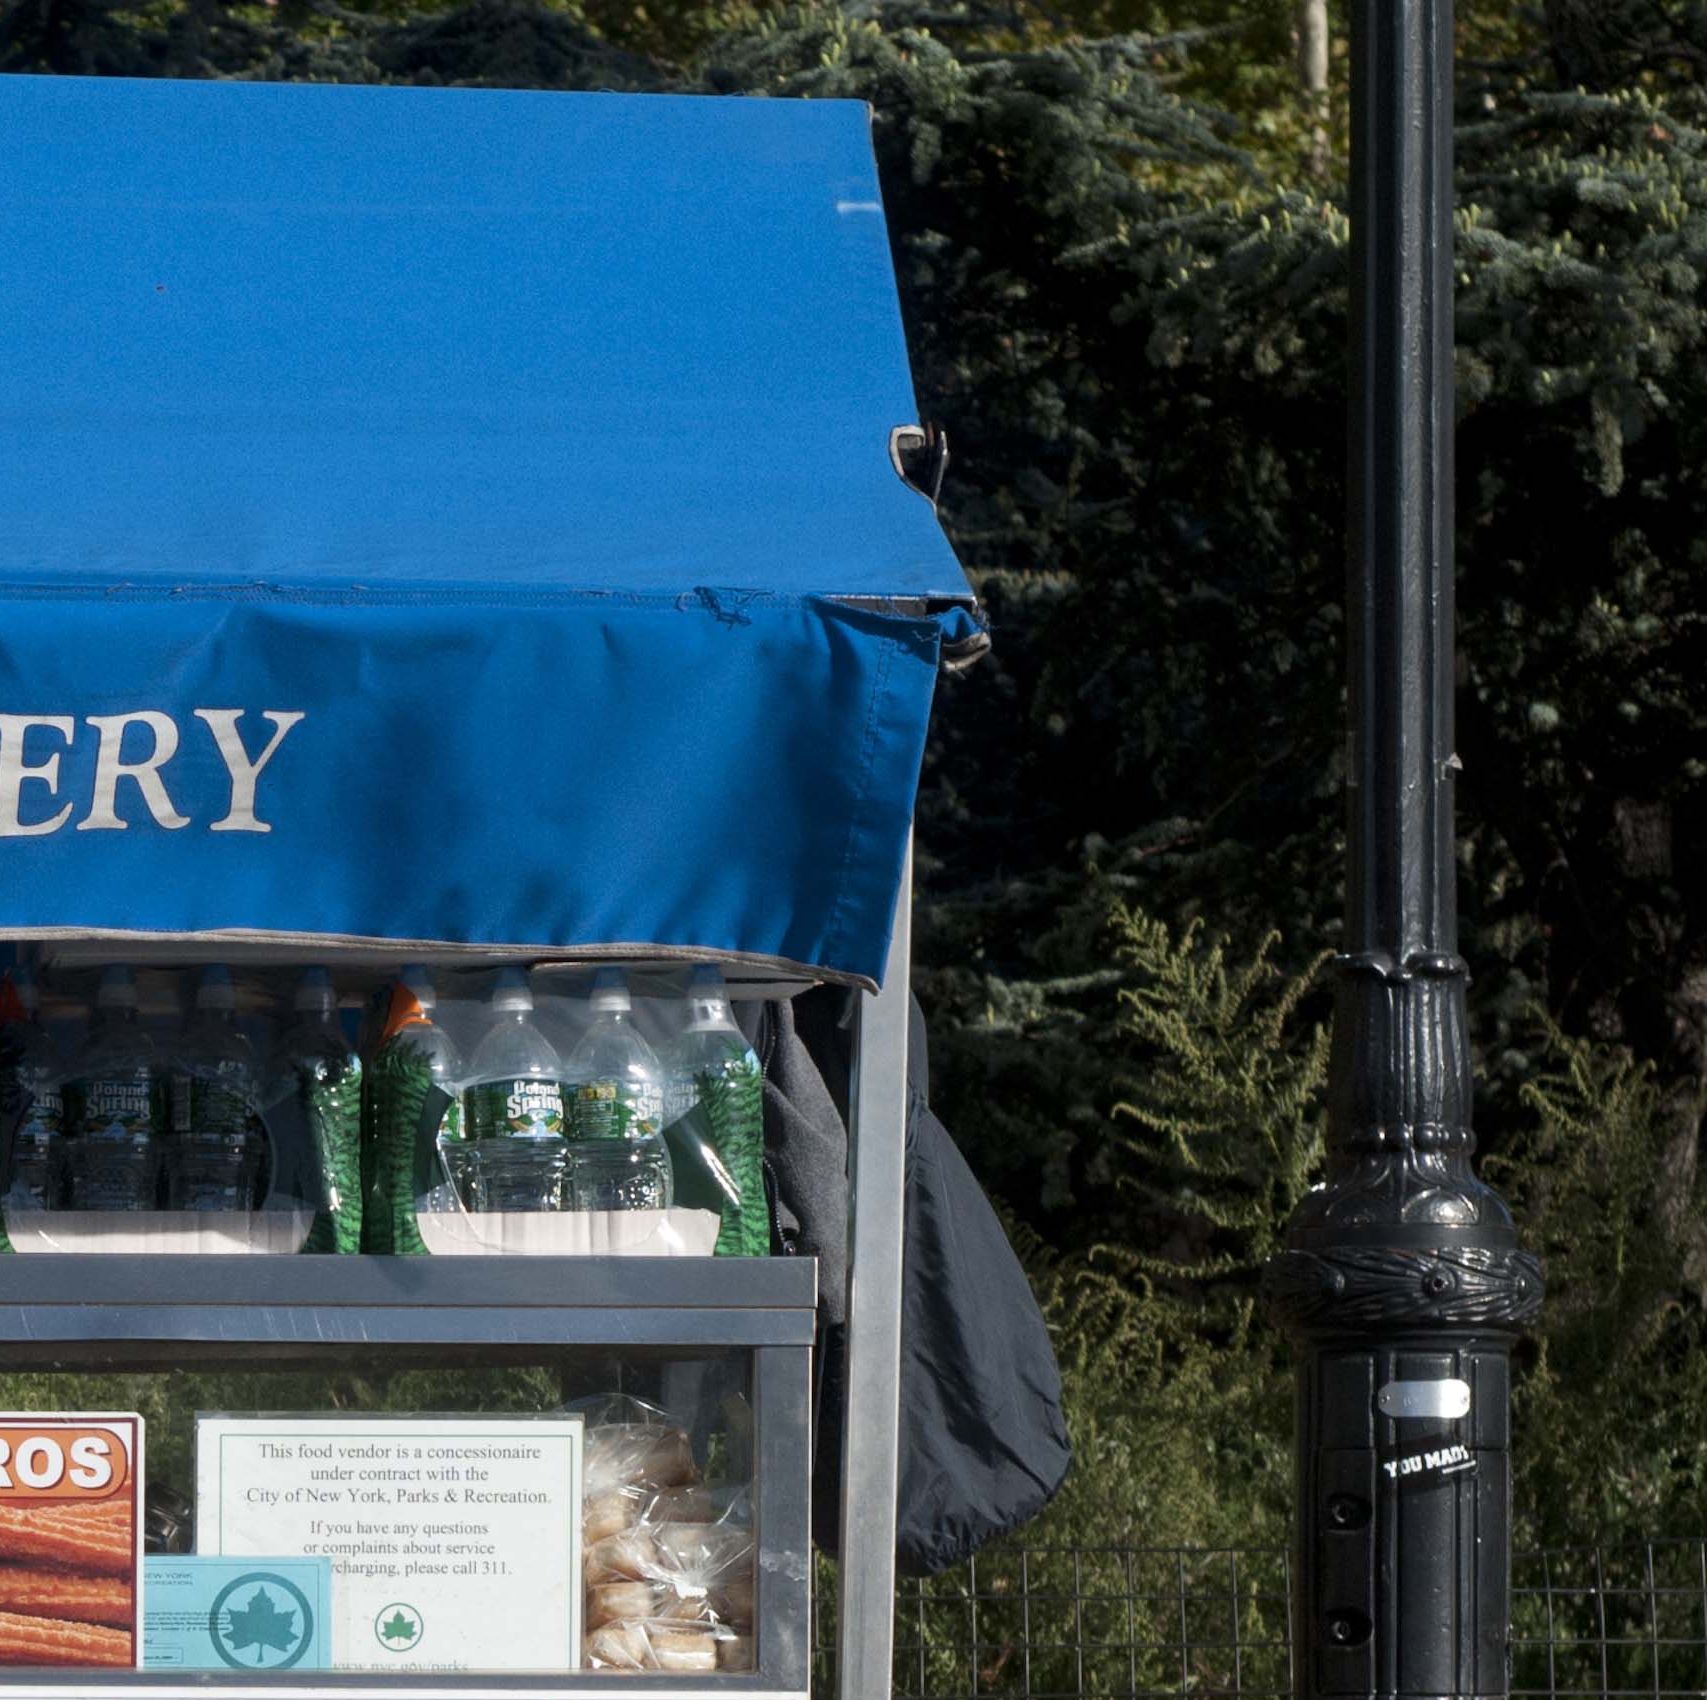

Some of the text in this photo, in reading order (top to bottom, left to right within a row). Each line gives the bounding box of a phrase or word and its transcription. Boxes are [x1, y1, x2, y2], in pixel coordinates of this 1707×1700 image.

[259, 1443, 541, 1460] This food vendor is a concessionaire
[311, 1467, 489, 1481] under contract with the
[1384, 1456, 1422, 1477] YOU
[247, 1488, 552, 1505] City of New York, Parks & Recreation.
[310, 1521, 488, 1539] If you have any questions
[303, 1542, 495, 1557] or complaints about service
[332, 1562, 512, 1578] rcharging, please call 311.
